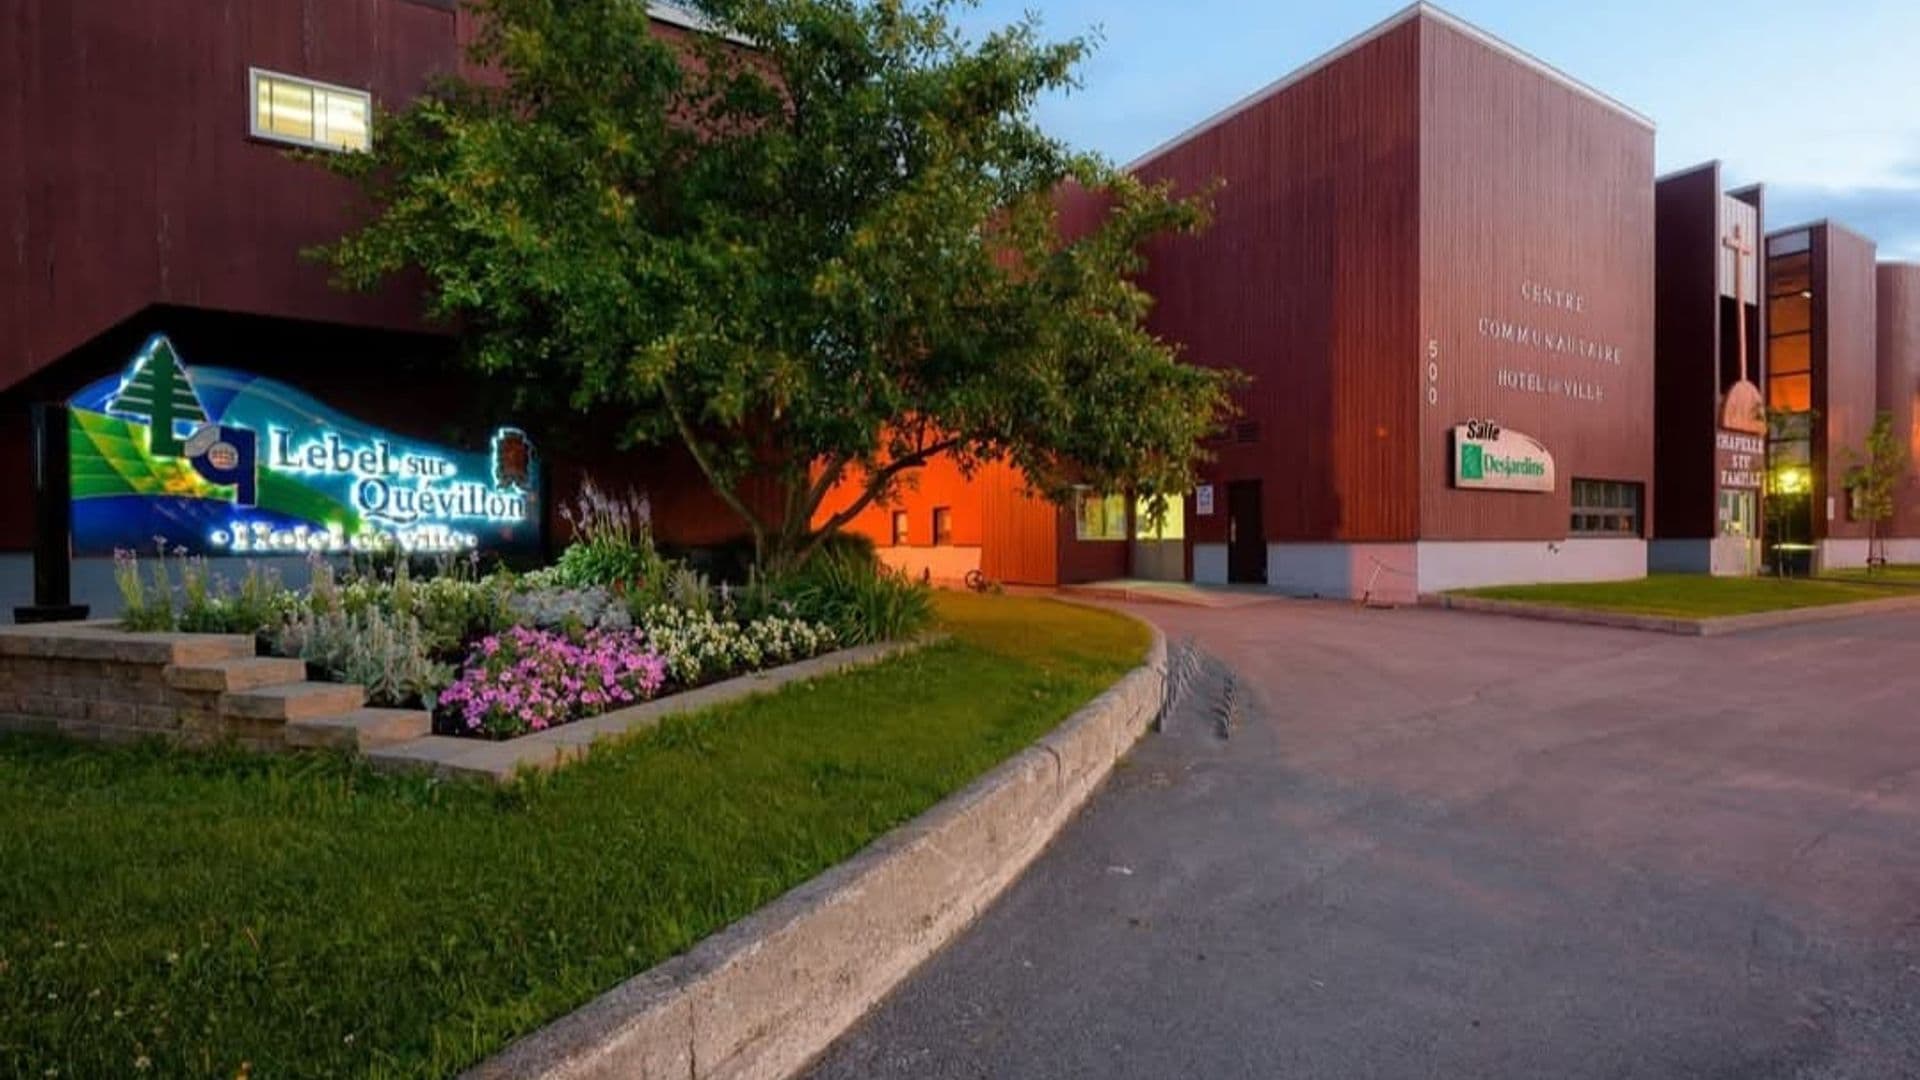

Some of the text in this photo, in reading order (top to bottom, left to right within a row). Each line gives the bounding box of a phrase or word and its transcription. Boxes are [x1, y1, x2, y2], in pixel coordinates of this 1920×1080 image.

[1521, 279, 1584, 312] CENTRE
[1478, 317, 1623, 365] COMMUNAUTAIRE
[1497, 369, 1545, 393] HOTEL
[1563, 379, 1606, 401] VILLE
[1466, 419, 1500, 441] Salle
[272, 428, 449, 476] Lebel sur
[1485, 453, 1545, 478] Desjardins
[357, 477, 527, 523] Quévillon
